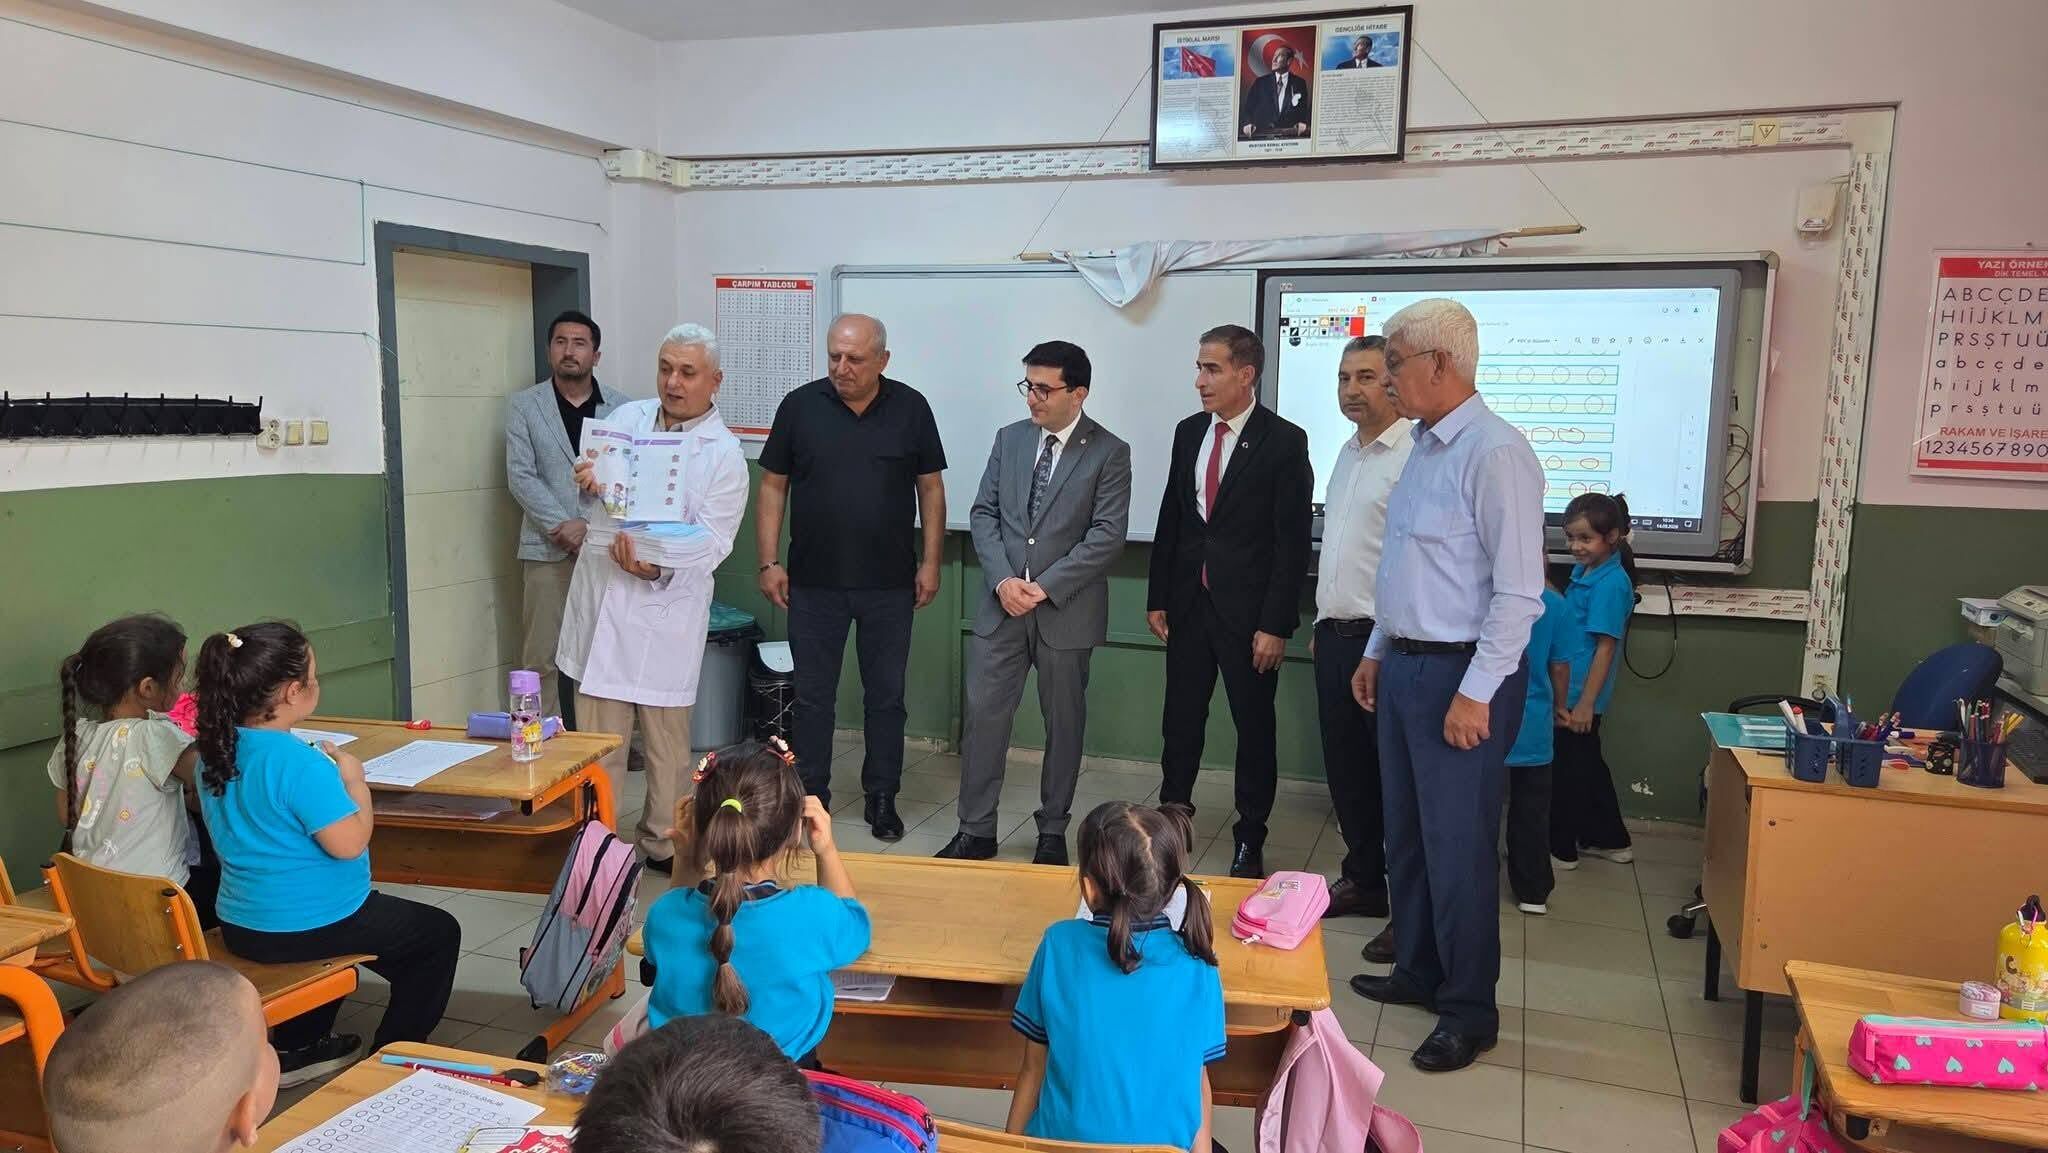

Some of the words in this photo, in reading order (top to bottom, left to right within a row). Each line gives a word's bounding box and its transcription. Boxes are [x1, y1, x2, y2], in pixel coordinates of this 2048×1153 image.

[1978, 261, 2005, 269] YAZI
[732, 280, 761, 288] ÇARPIM
[762, 280, 797, 289] TABLOSU
[1940, 427, 1986, 438] RAKAM
[1990, 427, 2007, 438] VE
